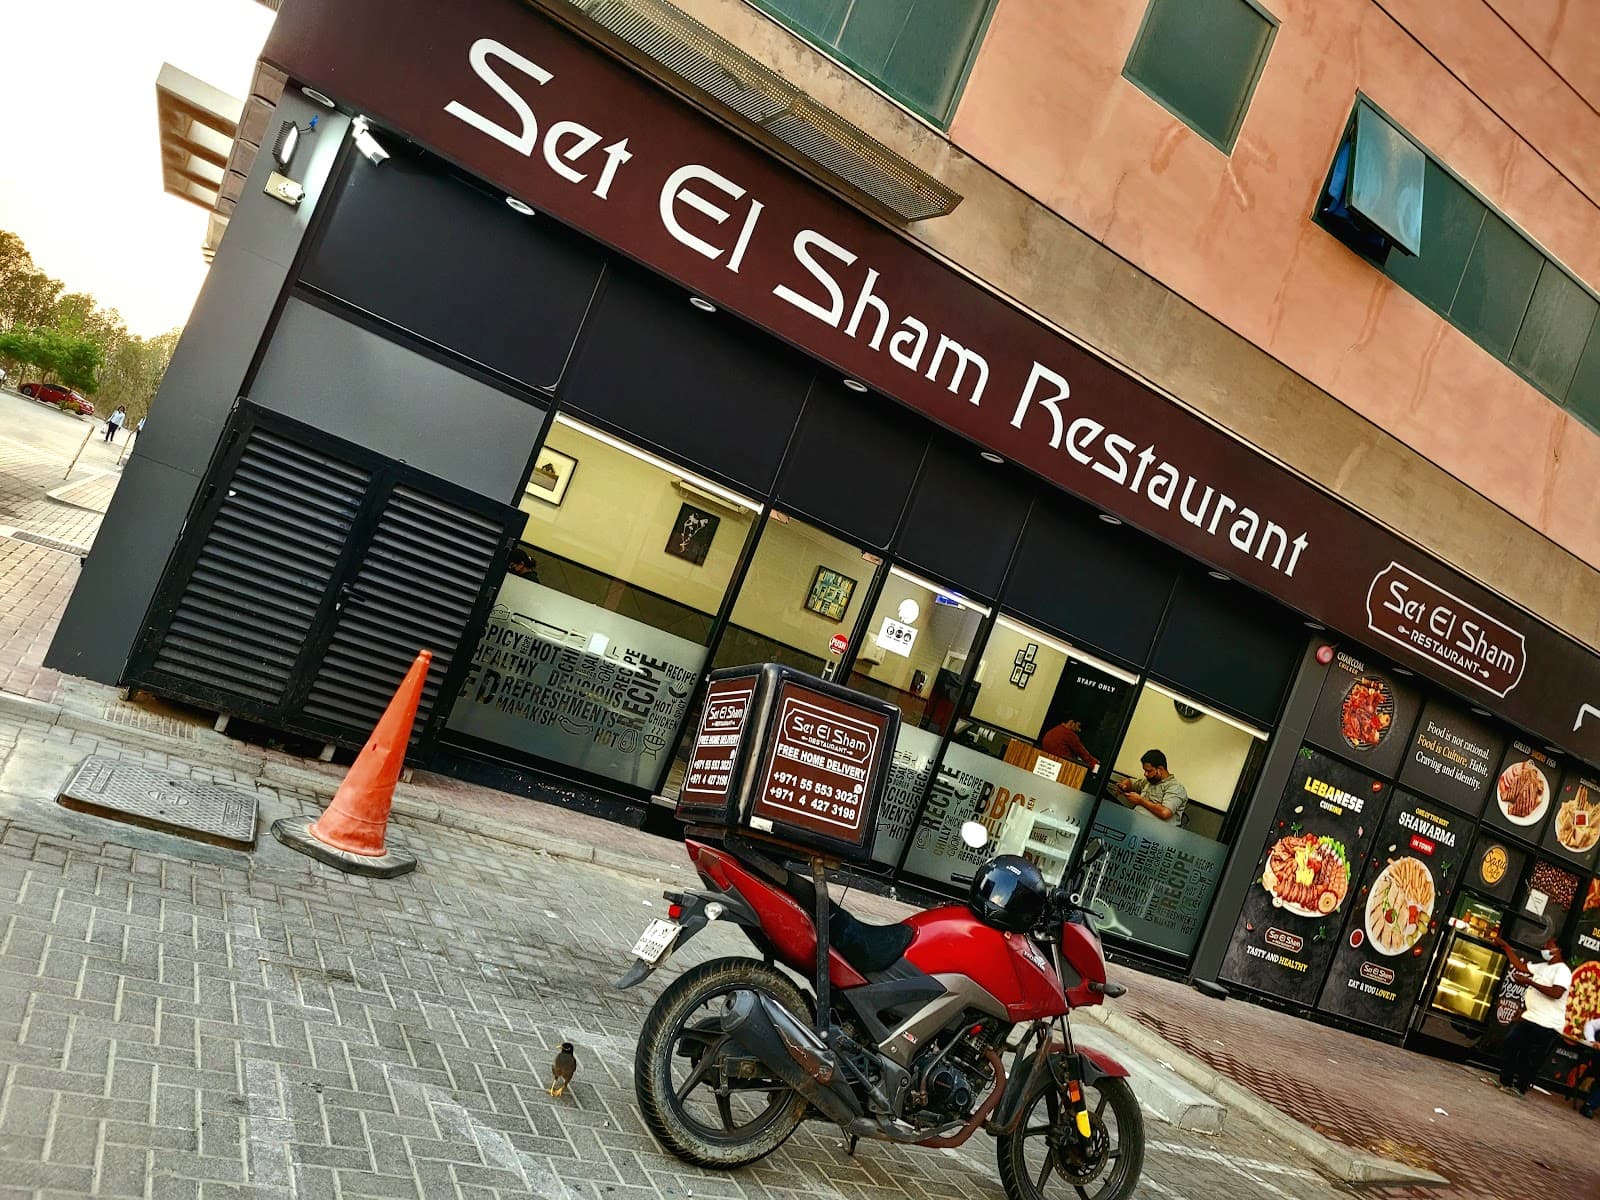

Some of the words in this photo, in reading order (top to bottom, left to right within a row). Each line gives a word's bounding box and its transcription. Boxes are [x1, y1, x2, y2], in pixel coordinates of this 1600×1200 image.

[443, 38, 633, 200] Set
[659, 164, 765, 274] El
[772, 229, 990, 407] Sham
[1009, 360, 1309, 578] Restaurant
[830, 637, 846, 650] PUSH
[1383, 580, 1427, 624] Set
[1429, 606, 1457, 640] El
[1456, 620, 1515, 674] Sham
[528, 638, 562, 664] HOT
[1337, 651, 1365, 672] CHARCOAL
[1410, 630, 1480, 674] RESTAURANT
[613, 648, 641, 691] RECPE
[665, 663, 697, 685] RECIPE
[1077, 676, 1097, 687] STAFF
[1098, 683, 1116, 693] ONLY
[501, 675, 620, 728] REFRESHMENTS
[547, 669, 623, 709] DELICIOUS
[619, 653, 670, 731] RECIPE
[496, 696, 558, 727] MANAKISH
[648, 713, 677, 729] CHICKEN
[594, 727, 620, 748] HOT
[792, 716, 815, 735] Set
[816, 724, 831, 740] El
[832, 730, 866, 752] Sham
[808, 736, 847, 753] RESTAURANT
[1427, 721, 1447, 739] Food
[1445, 729, 1452, 741] is
[1451, 735, 1464, 747] not
[1463, 741, 1490, 760] rational.
[777, 743, 800, 759] FREE
[800, 749, 826, 767] HOME
[826, 758, 866, 780] DELIVERY
[1415, 750, 1442, 774] Craving
[1441, 765, 1456, 777] and
[1455, 769, 1481, 791] identity.
[1417, 734, 1437, 751] Food
[1435, 742, 1442, 754] is
[1442, 746, 1468, 768] Culture,
[1468, 759, 1488, 777] Habit,
[773, 771, 798, 787] +971
[799, 778, 813, 791] 55
[814, 782, 833, 797] 553
[834, 788, 859, 805] 3023
[959, 772, 983, 790] RECIPE
[1304, 776, 1364, 814] LEBANESE
[769, 786, 794, 802] +971
[798, 794, 806, 806] 4
[810, 798, 830, 812] 427
[831, 804, 855, 820] 3198
[960, 807, 972, 819] HOT
[889, 823, 910, 841] HOT
[934, 824, 952, 855] CHILLY
[1399, 811, 1457, 848] SHAWARMA
[1115, 848, 1134, 865] HOT
[1133, 837, 1152, 871] CHILLY
[1158, 846, 1177, 881] RECIPE
[1160, 850, 1195, 911] RECIPE
[1145, 894, 1161, 921] CHILLY
[1246, 945, 1265, 959] TASTY
[1265, 952, 1279, 963] AND
[1278, 956, 1308, 973] HEALTHY
[1347, 978, 1359, 989] EAT
[1364, 983, 1376, 994] YOU
[1375, 987, 1389, 998] LOVE
